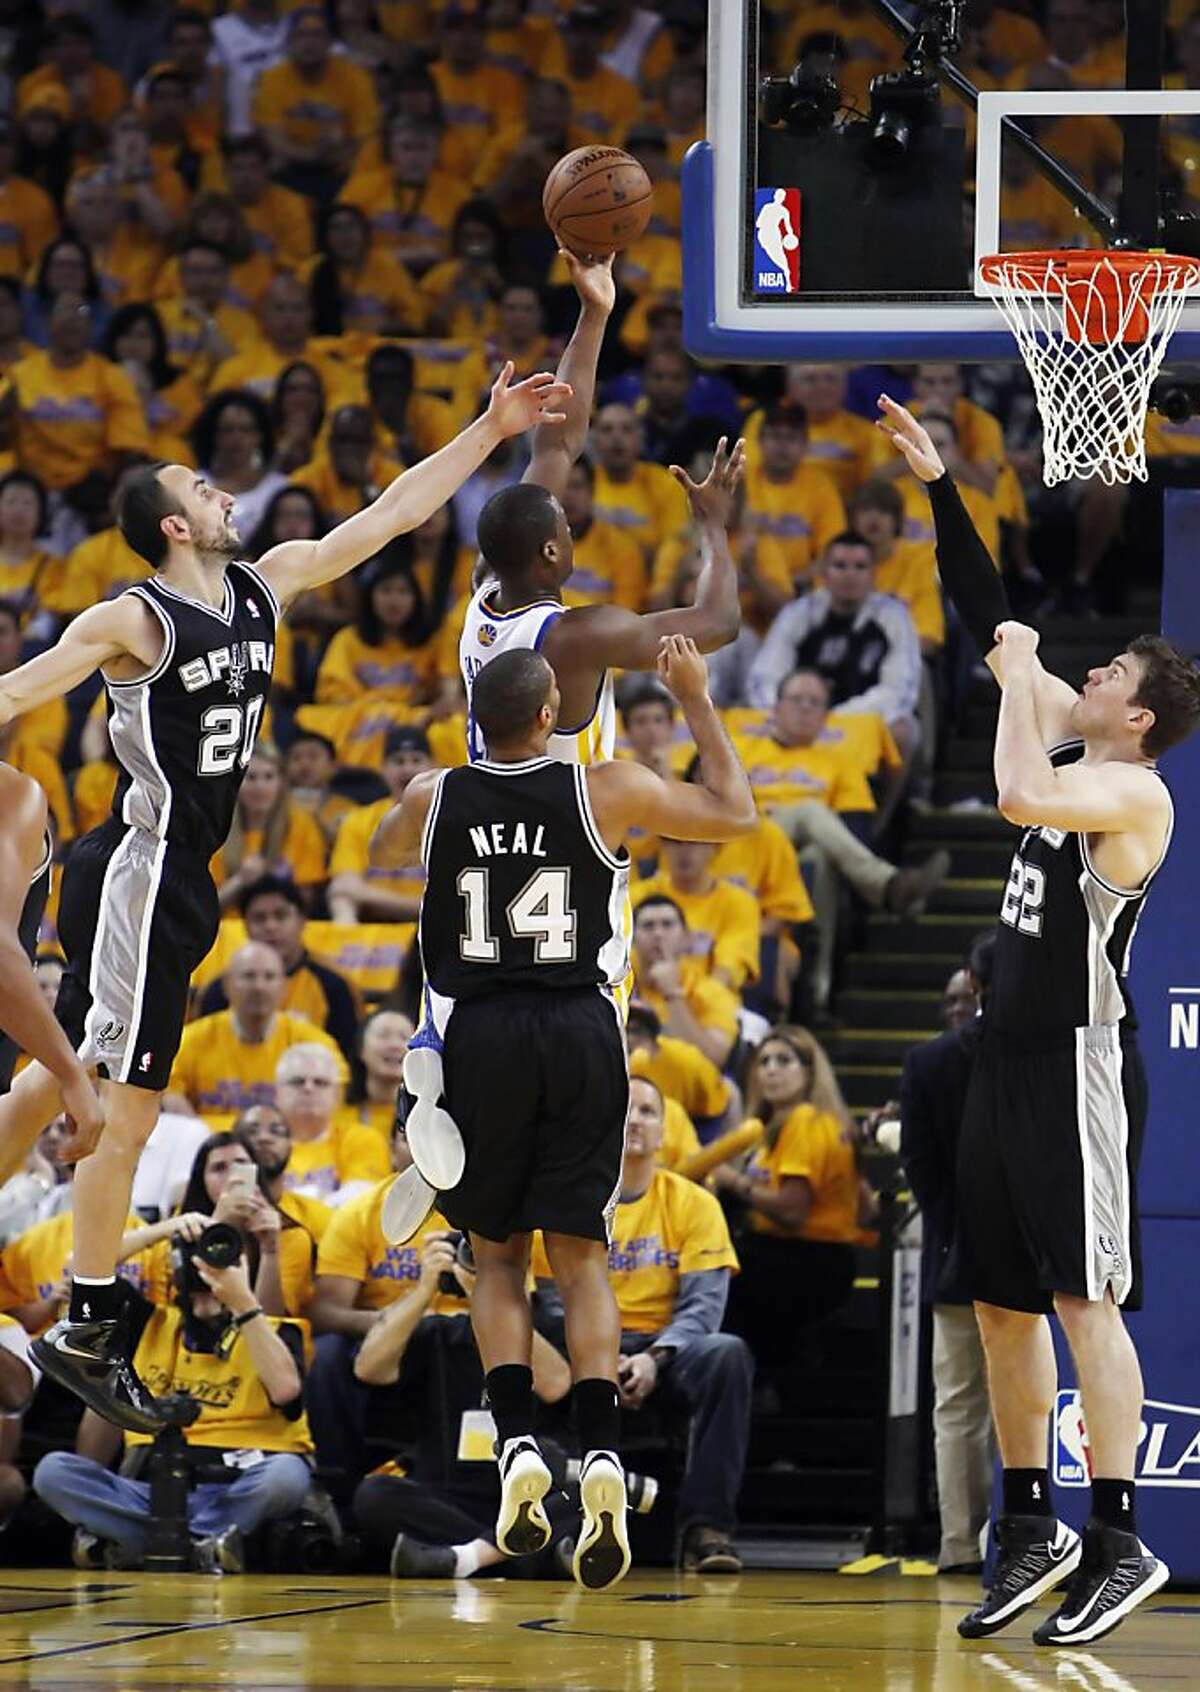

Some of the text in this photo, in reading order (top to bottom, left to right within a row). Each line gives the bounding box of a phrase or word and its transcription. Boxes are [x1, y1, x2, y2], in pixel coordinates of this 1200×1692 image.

[759, 272, 785, 288] NBA
[197, 694, 264, 776] 20
[469, 822, 547, 858] NEAL
[456, 866, 577, 964] 14
[1000, 852, 1047, 938] 22
